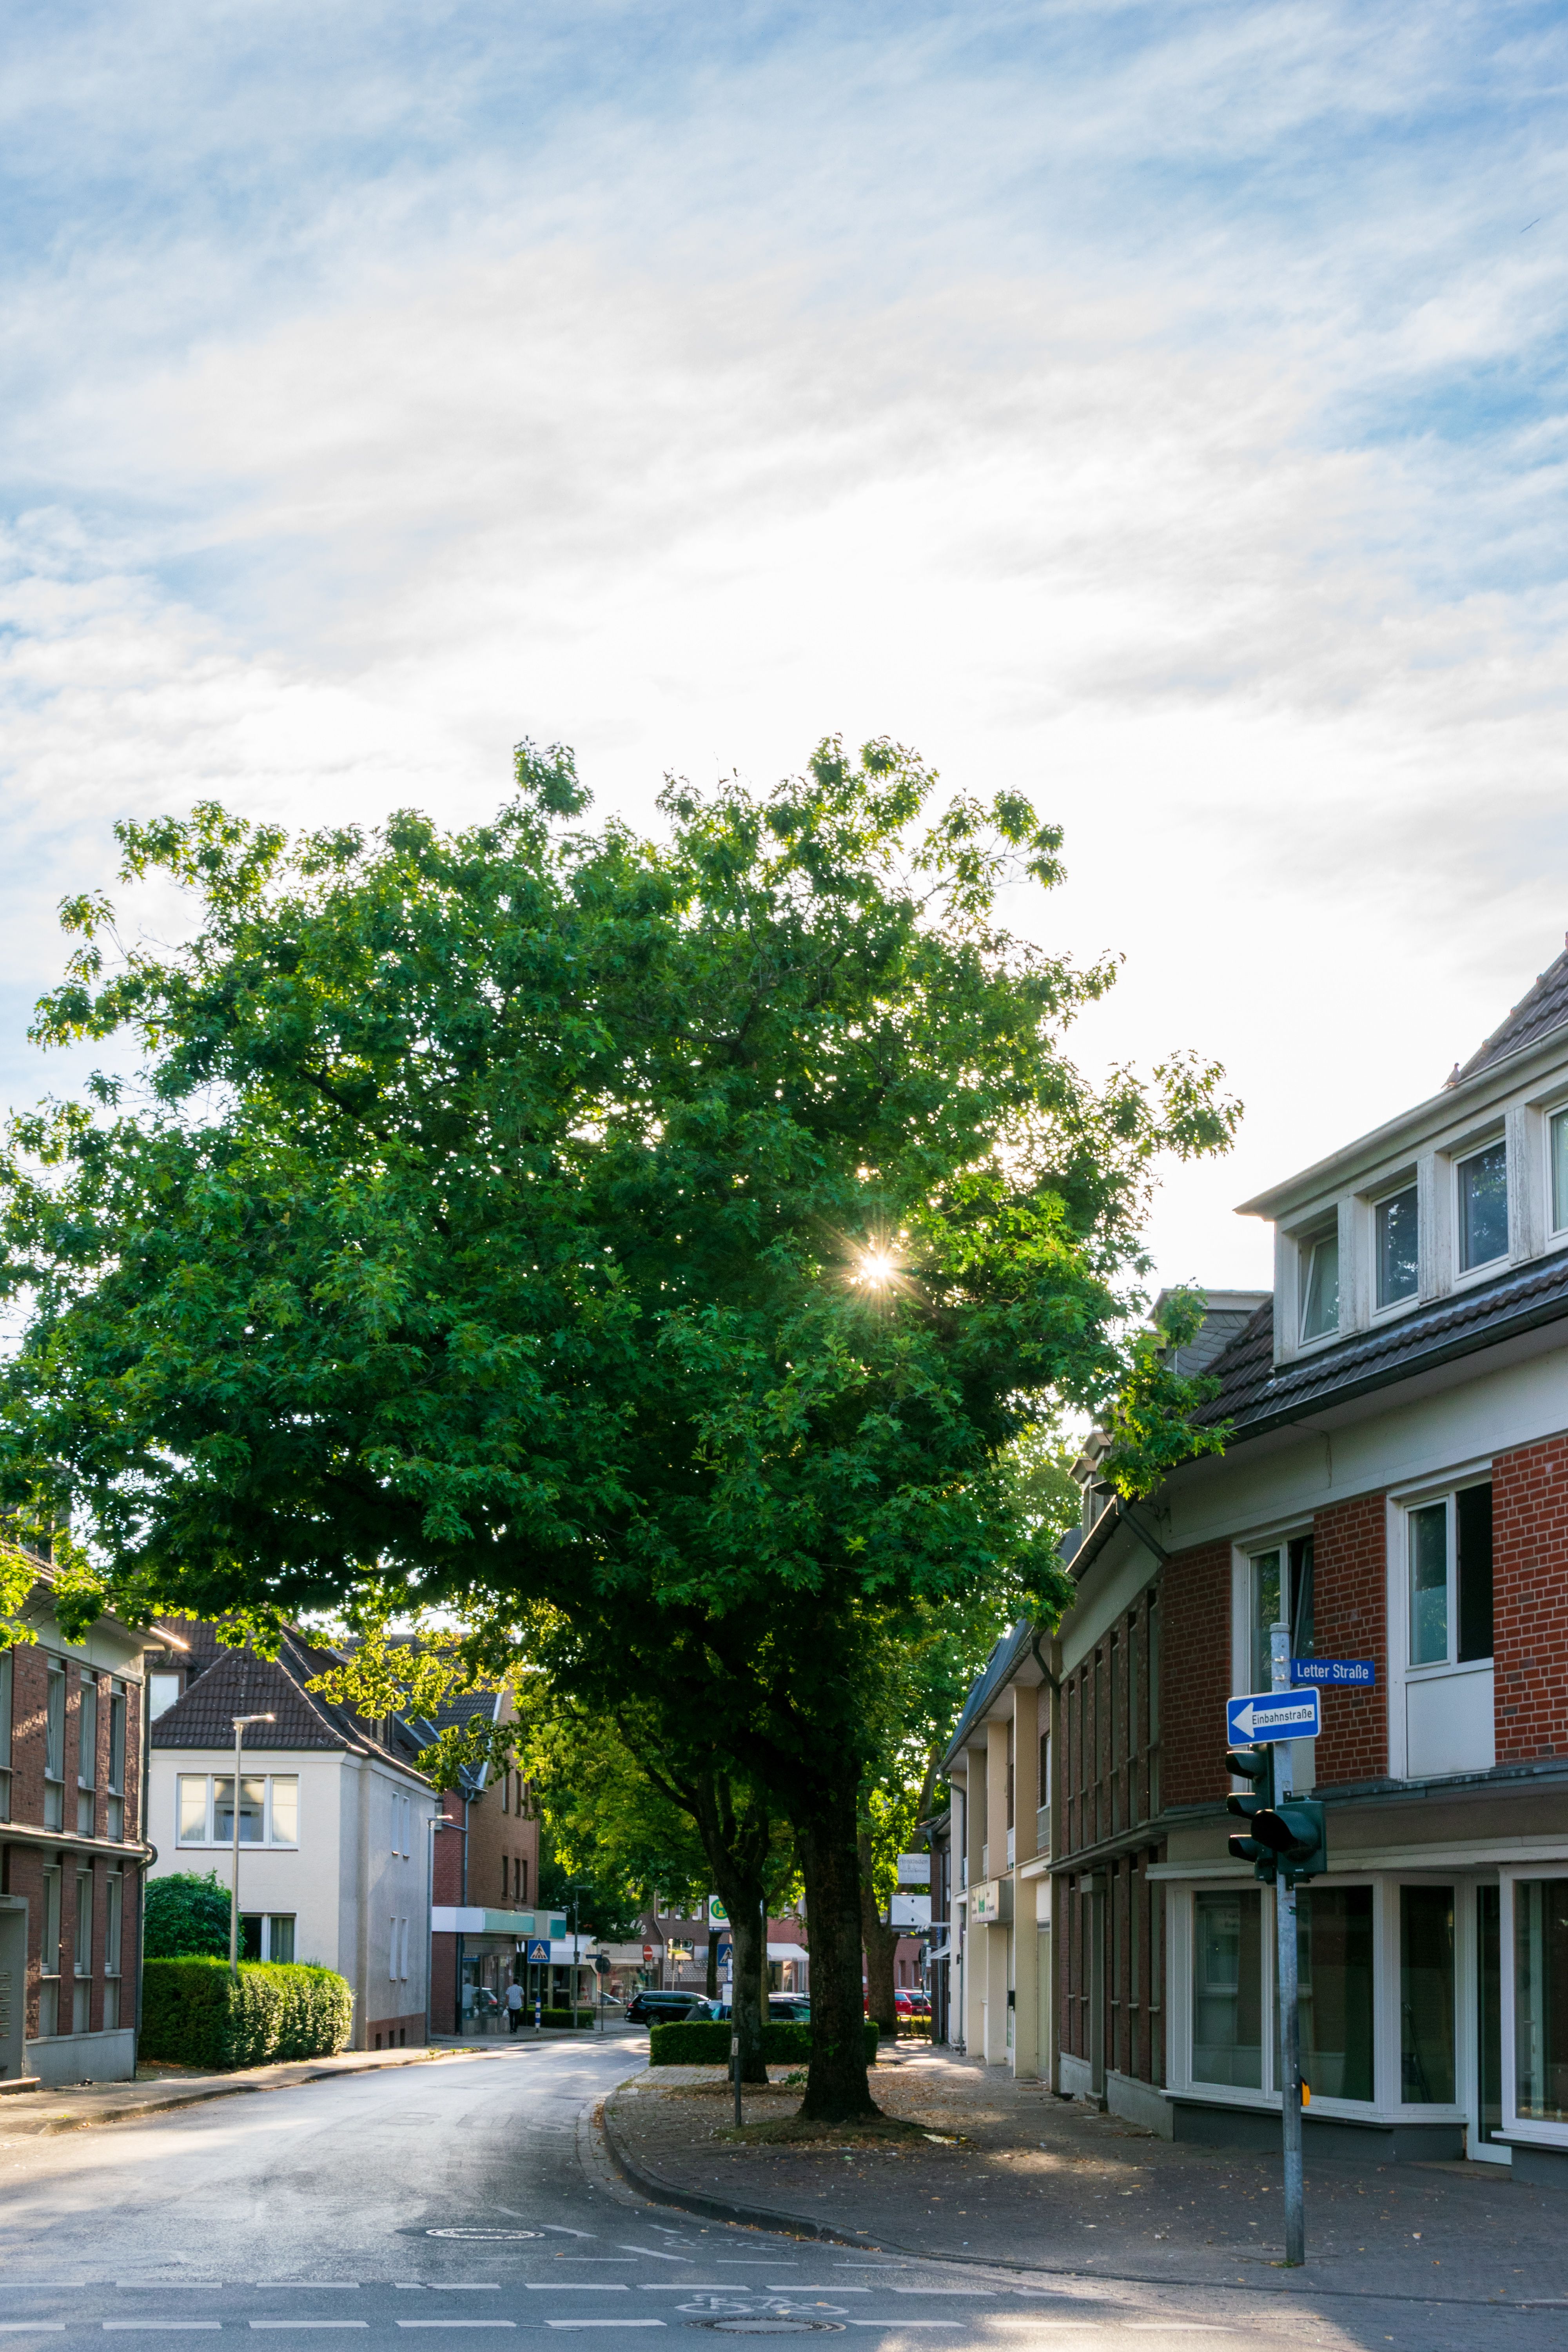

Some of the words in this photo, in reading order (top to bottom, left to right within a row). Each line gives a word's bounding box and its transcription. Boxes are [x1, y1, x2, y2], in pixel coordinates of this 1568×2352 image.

[1297, 1663, 1329, 1678] Letter
[1333, 1664, 1368, 1679] Straße
[1252, 1708, 1312, 1724] Einbahnstraße
[716, 1903, 726, 1915] H
